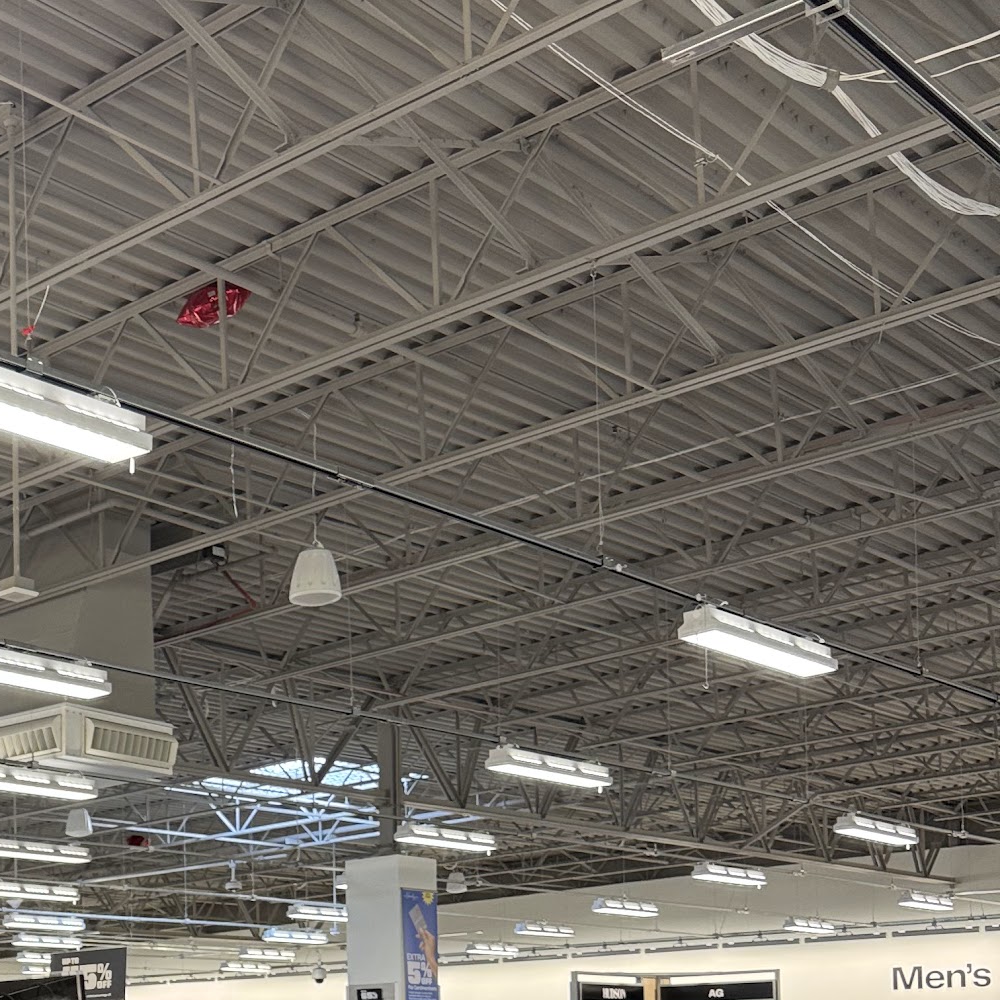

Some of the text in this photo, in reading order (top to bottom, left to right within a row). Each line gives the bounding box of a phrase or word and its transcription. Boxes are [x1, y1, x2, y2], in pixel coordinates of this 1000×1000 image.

[407, 953, 426, 961] EXTRA
[97, 981, 112, 989] OFF
[708, 988, 725, 998] AG
